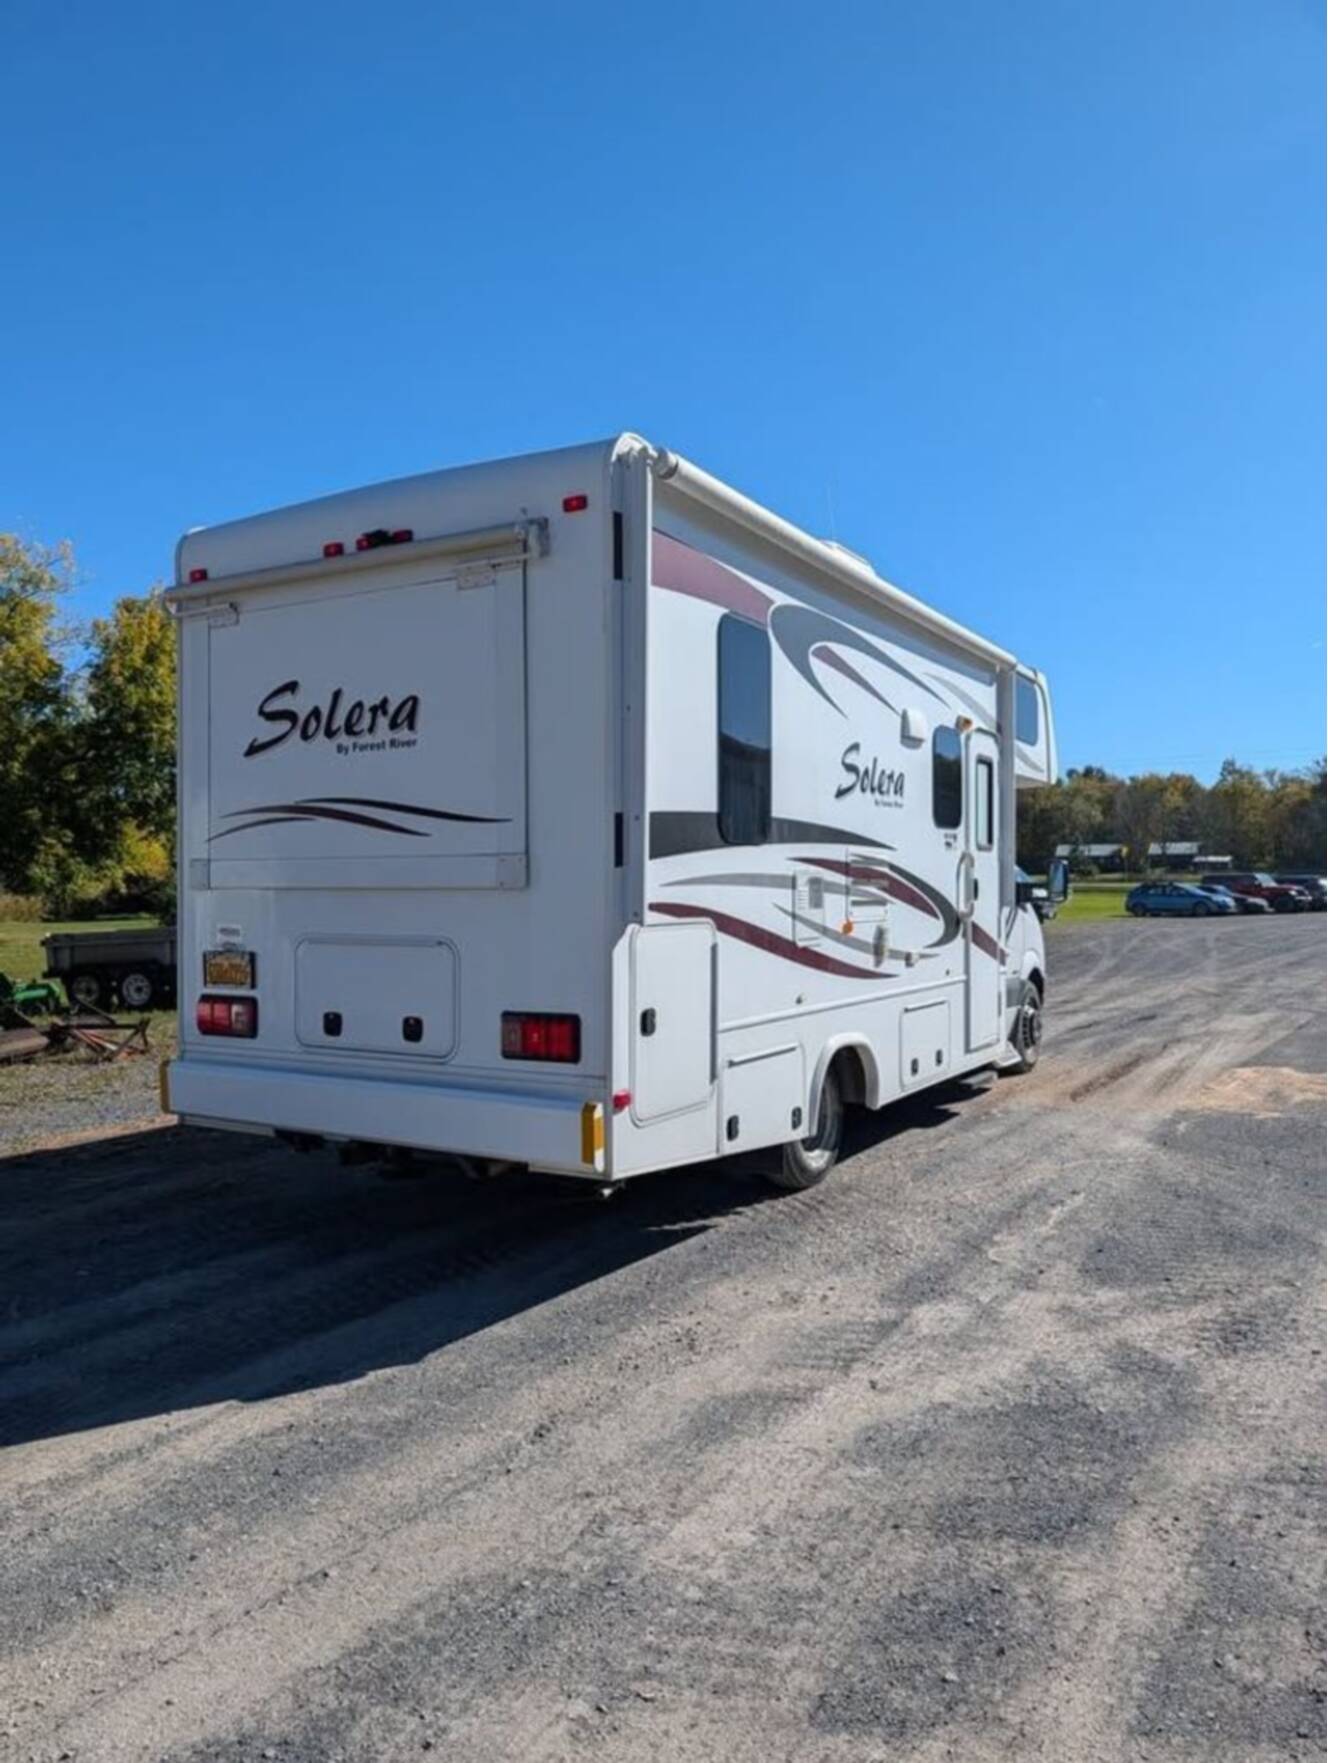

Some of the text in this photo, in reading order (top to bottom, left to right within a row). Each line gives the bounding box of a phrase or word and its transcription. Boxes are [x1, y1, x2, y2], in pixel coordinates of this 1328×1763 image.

[243, 680, 420, 757] Solera
[336, 738, 418, 755] By Forest River
[834, 741, 905, 799] Solera
